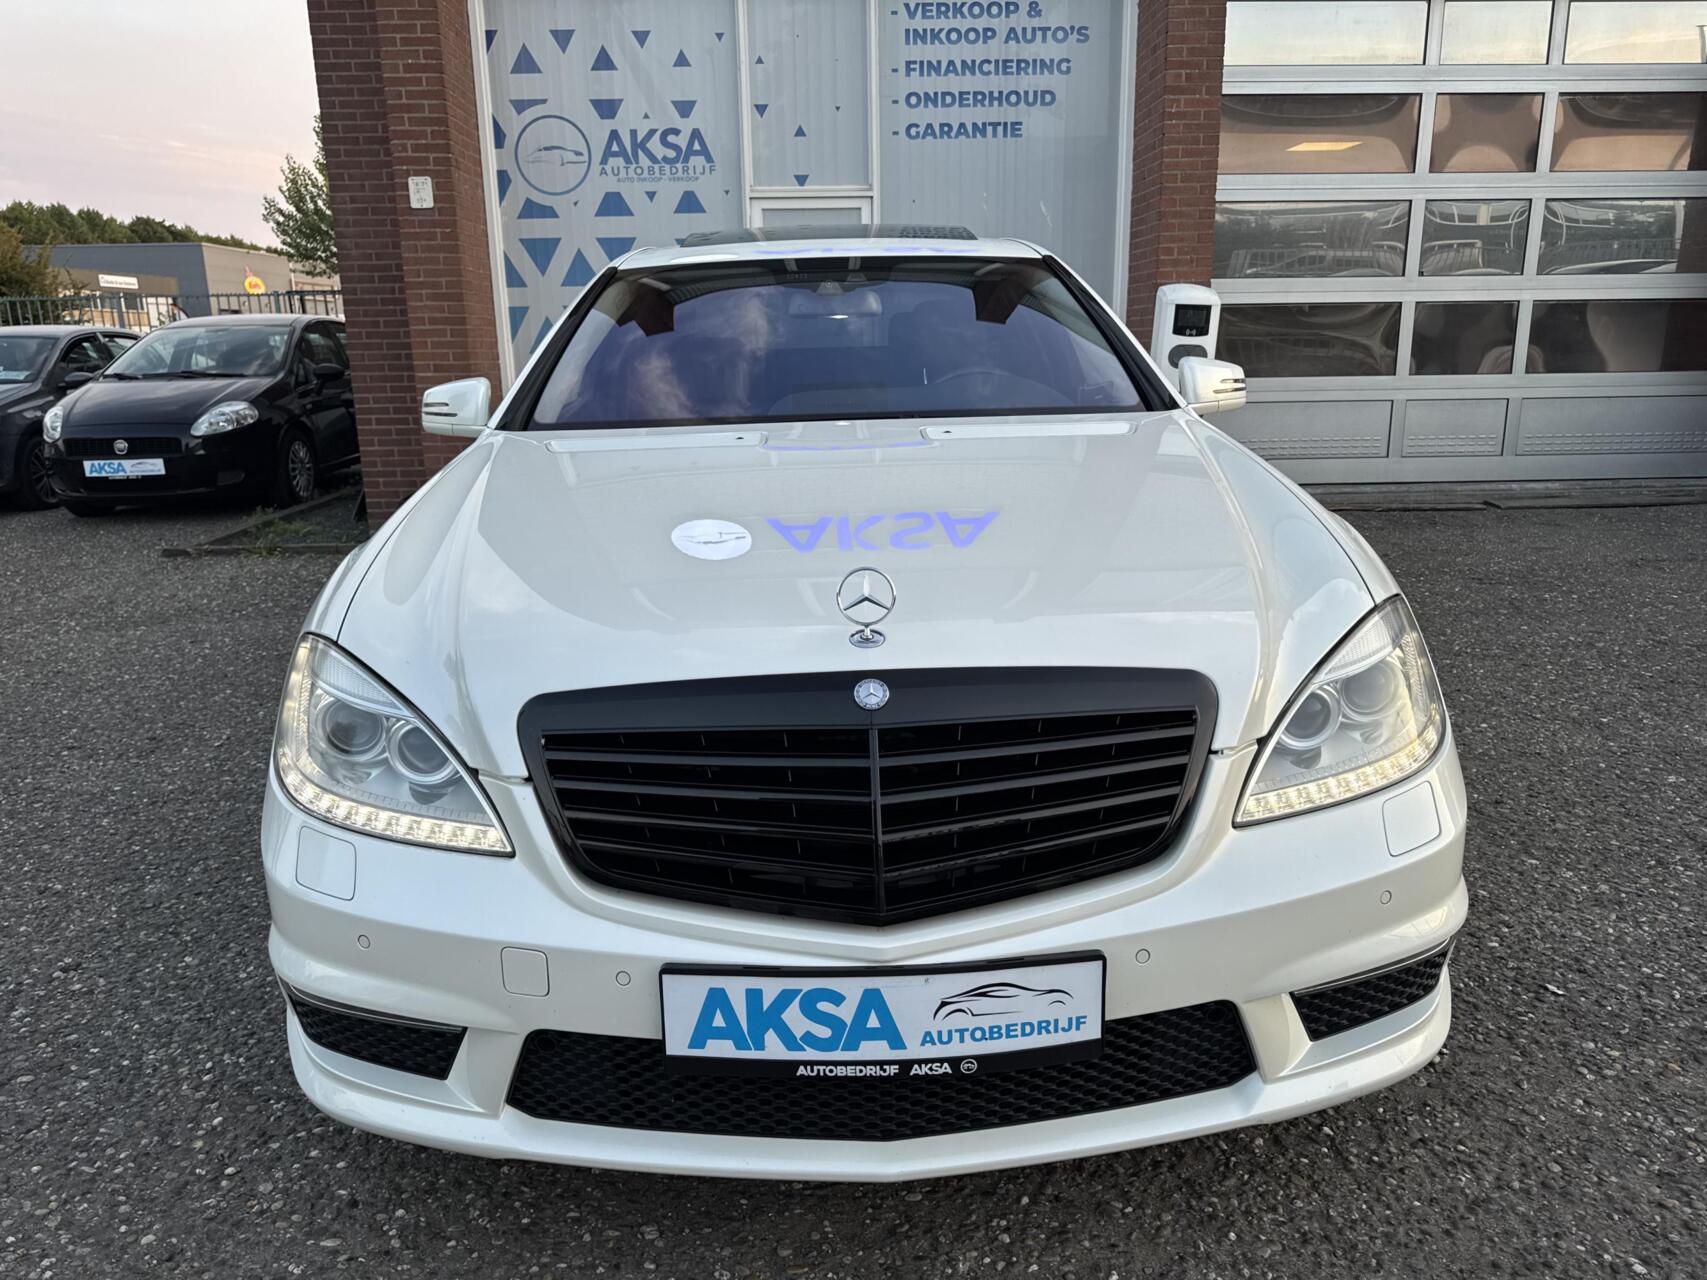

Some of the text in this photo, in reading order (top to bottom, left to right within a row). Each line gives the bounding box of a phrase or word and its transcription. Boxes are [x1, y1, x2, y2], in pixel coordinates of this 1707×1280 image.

[904, 1, 1020, 20] VERKOOP
[1026, 1, 1043, 18] &
[904, 25, 1090, 45] INKOOP AUTO'S
[905, 58, 1072, 77] FINANCIERING
[904, 90, 1057, 109] ONDERHOUD
[905, 121, 1023, 140] GARANTIE
[599, 127, 715, 166] AKSA
[599, 165, 717, 176] AUTOBEDRIJF
[89, 462, 127, 474] AKSA
[687, 987, 908, 1053] AKSA
[920, 1015, 1088, 1047] AUTOBEDRIJF
[796, 1063, 952, 1077] AUTOBEDRIJF AKSA
